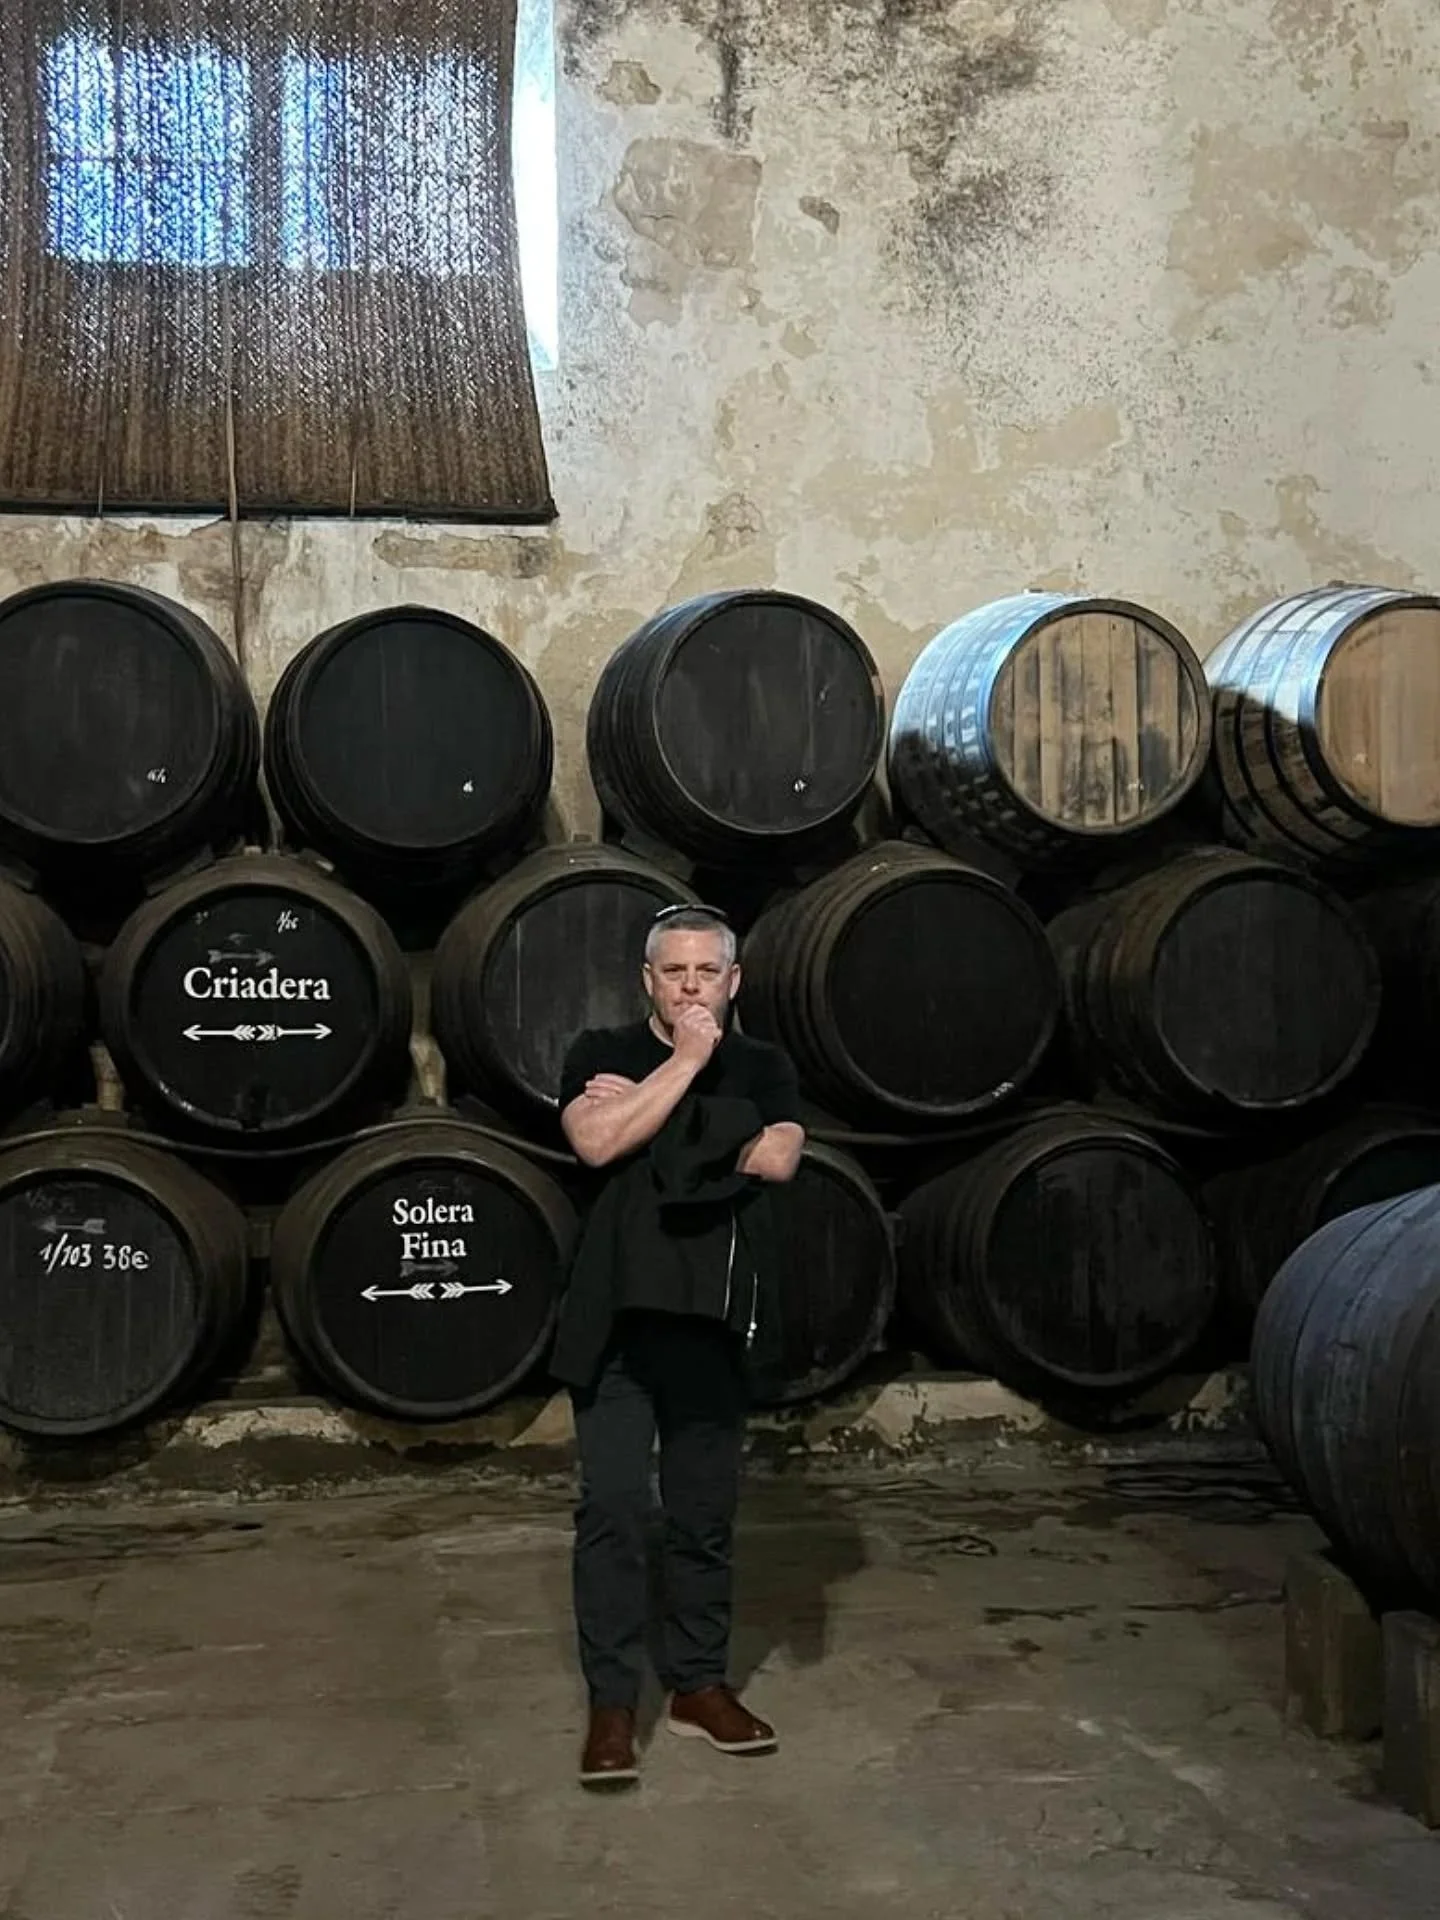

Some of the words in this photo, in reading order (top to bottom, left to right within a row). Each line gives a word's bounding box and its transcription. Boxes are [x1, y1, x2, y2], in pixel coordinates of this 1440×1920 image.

[183, 966, 332, 1001] Criadera
[392, 1196, 475, 1226] Solera
[38, 1231, 93, 1275] 1/103
[400, 1231, 468, 1260] Fina
